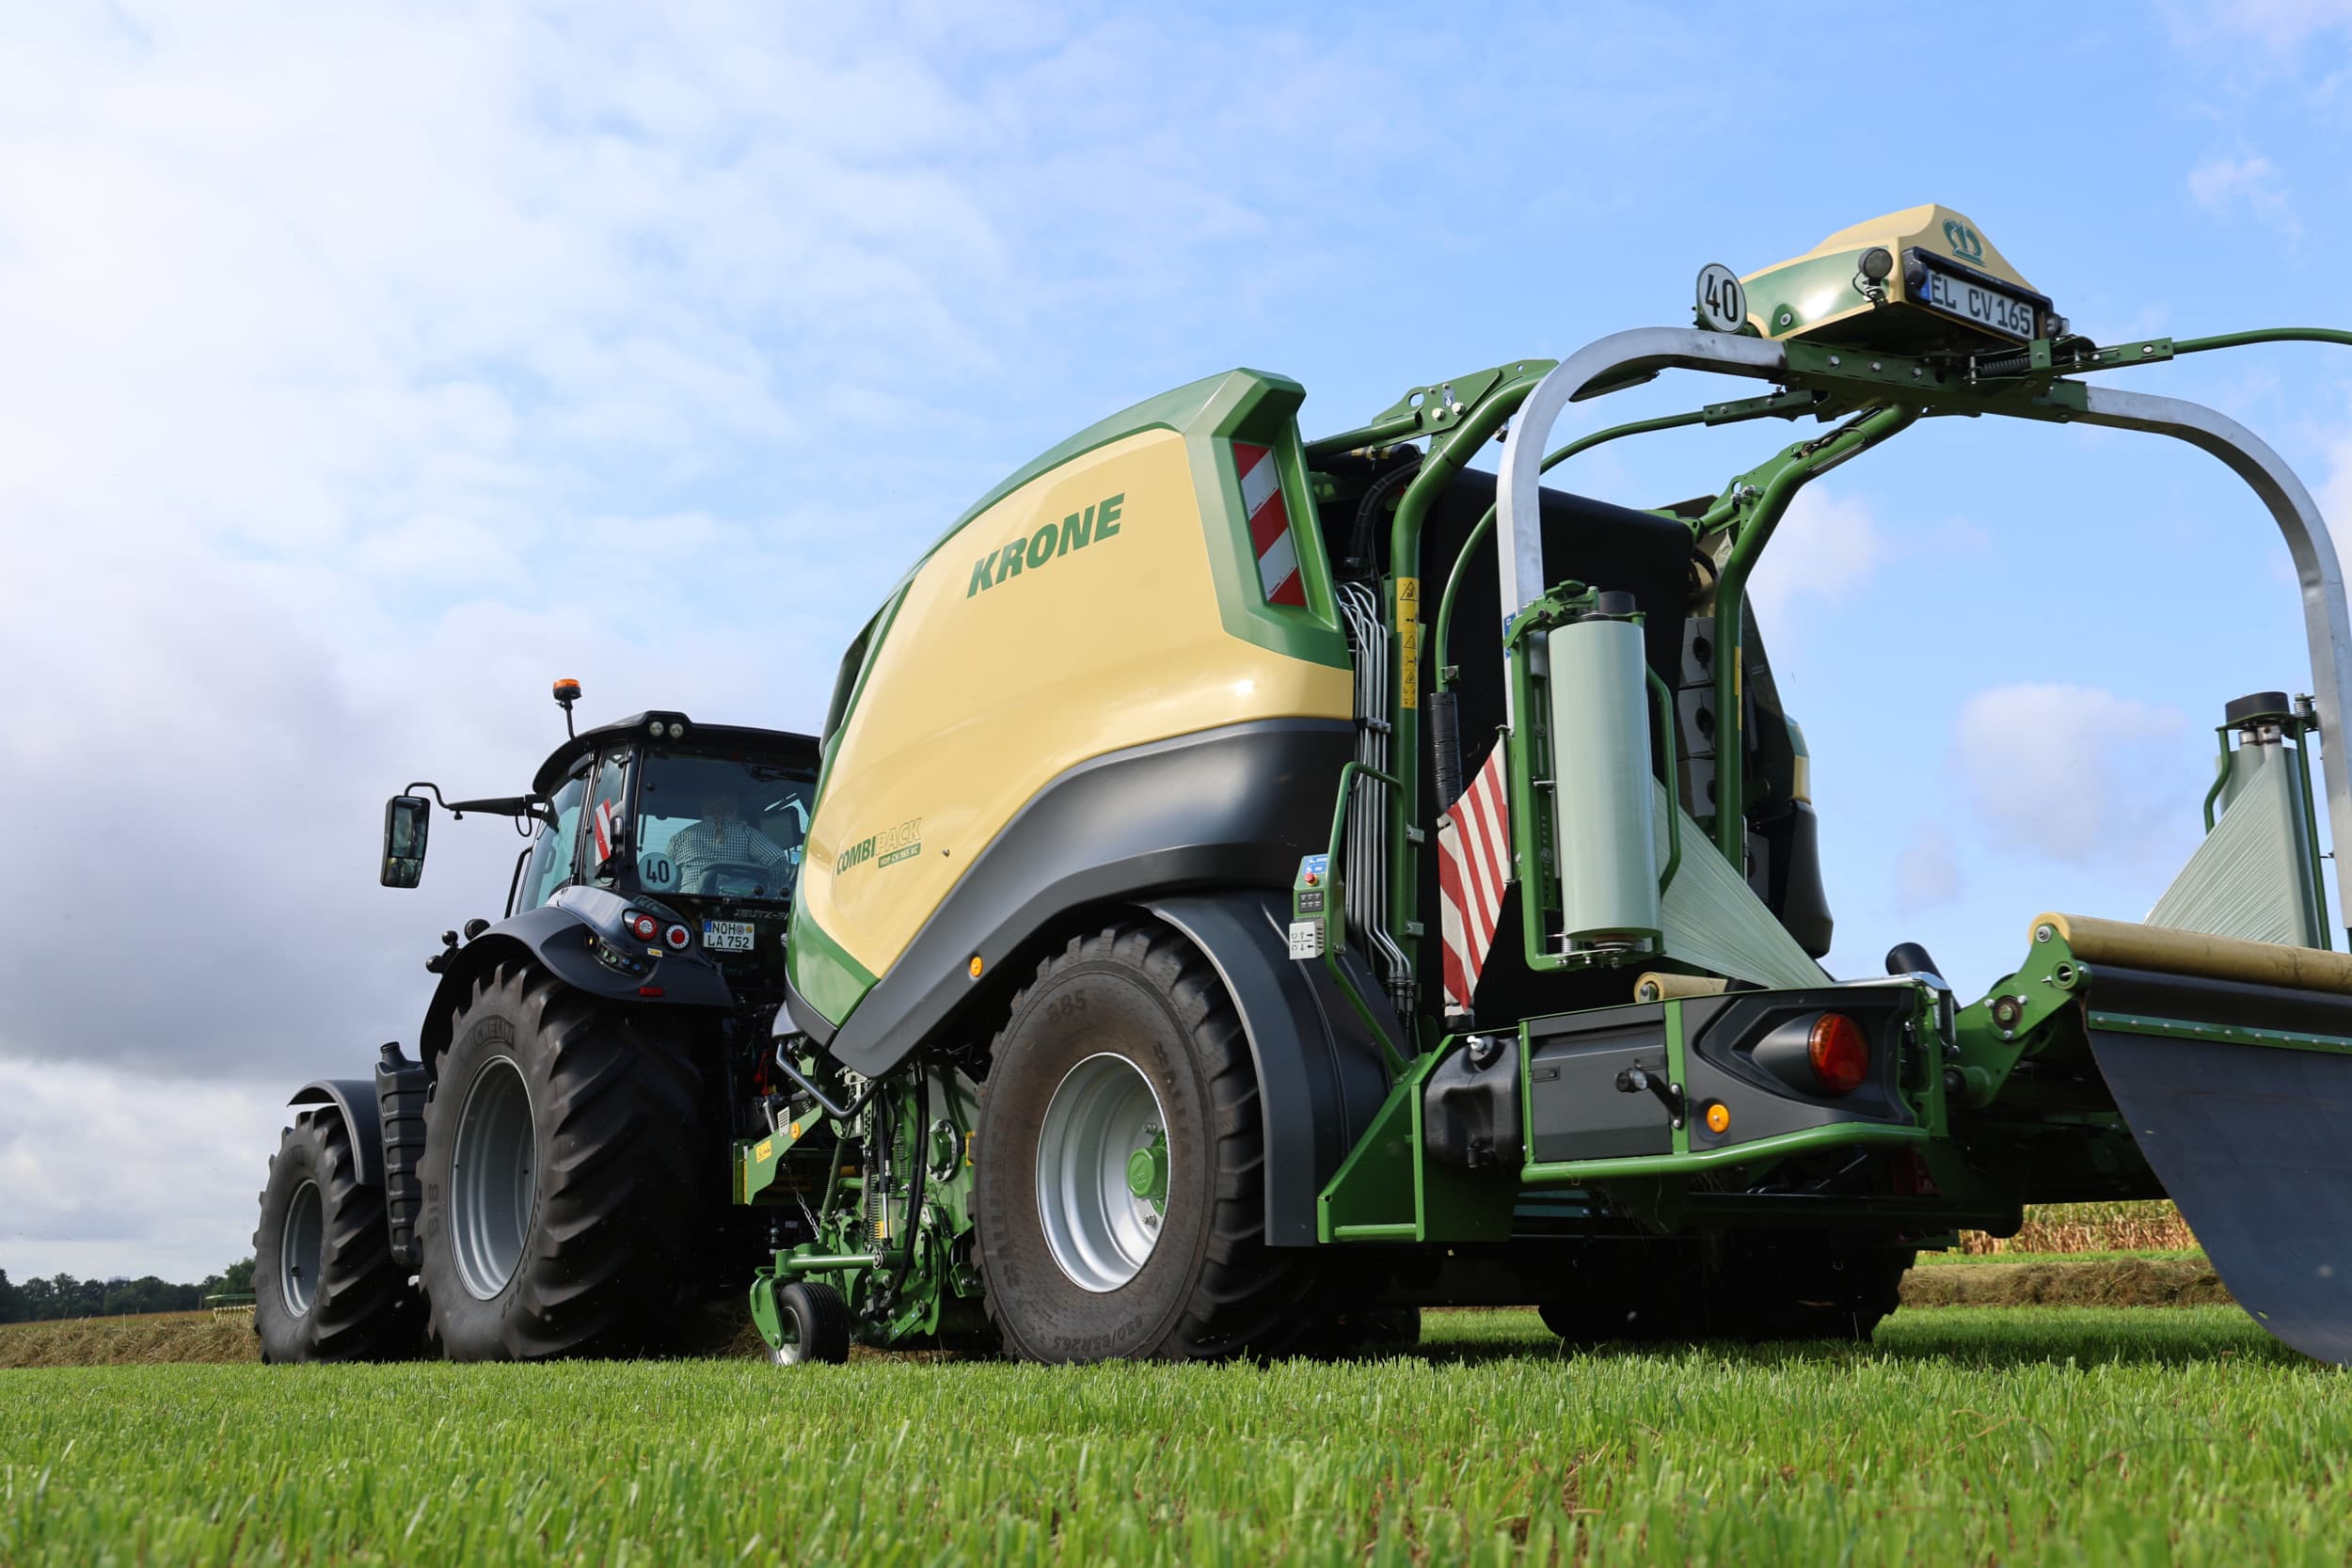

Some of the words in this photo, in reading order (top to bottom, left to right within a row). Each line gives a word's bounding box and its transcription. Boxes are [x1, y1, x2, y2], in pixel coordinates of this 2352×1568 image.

[1705, 274, 1739, 323] 40
[1931, 274, 1956, 309] EL
[1968, 288, 1993, 321] CV
[1997, 299, 2031, 335] 165
[966, 492, 1125, 599] KRONE
[645, 859, 670, 883] 40
[707, 935, 723, 947] LA
[727, 936, 750, 949] 752
[712, 922, 736, 935] NOH
